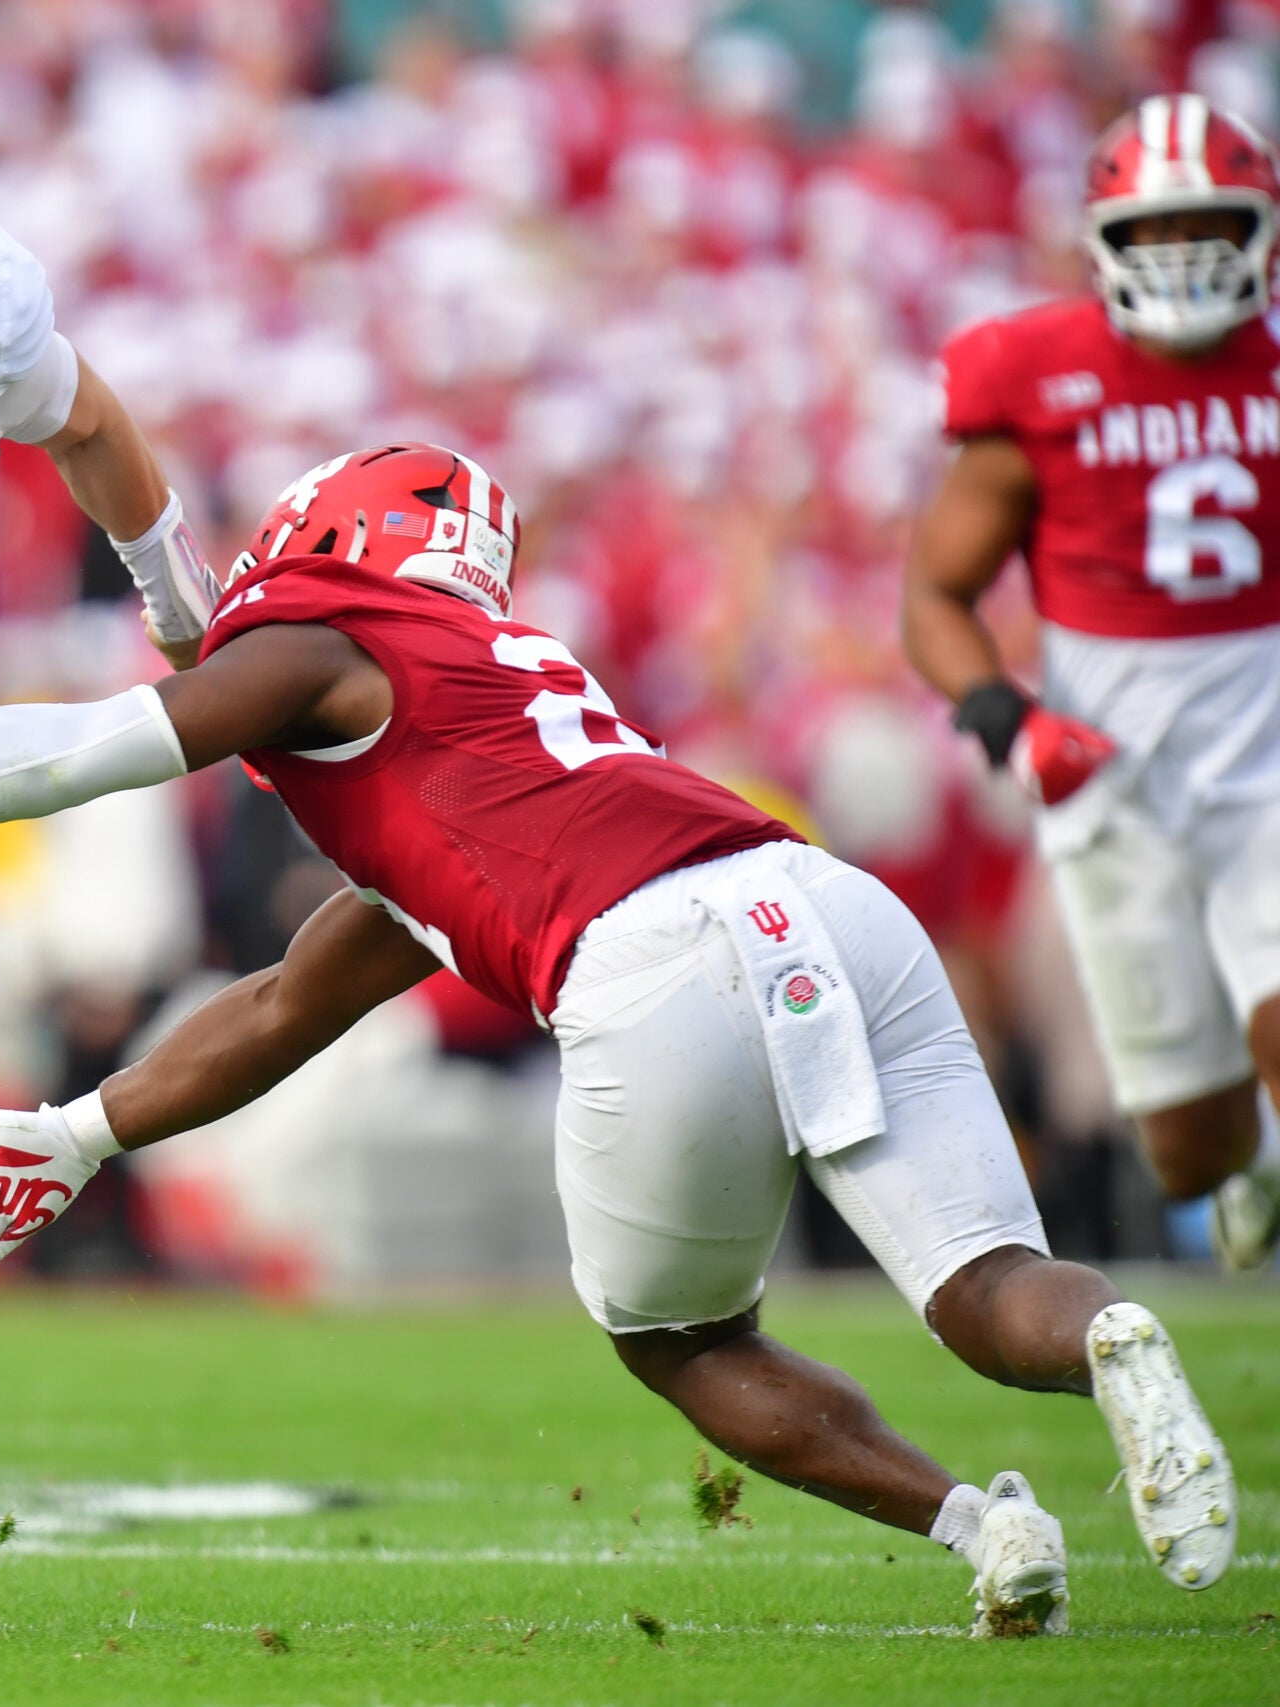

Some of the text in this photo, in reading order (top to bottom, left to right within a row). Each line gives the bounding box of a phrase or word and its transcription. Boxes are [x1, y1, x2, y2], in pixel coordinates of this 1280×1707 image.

[1076, 394, 1280, 469] INDIAN
[1145, 454, 1262, 602] 6
[451, 559, 510, 618] INDIAN
[490, 632, 667, 772] 2
